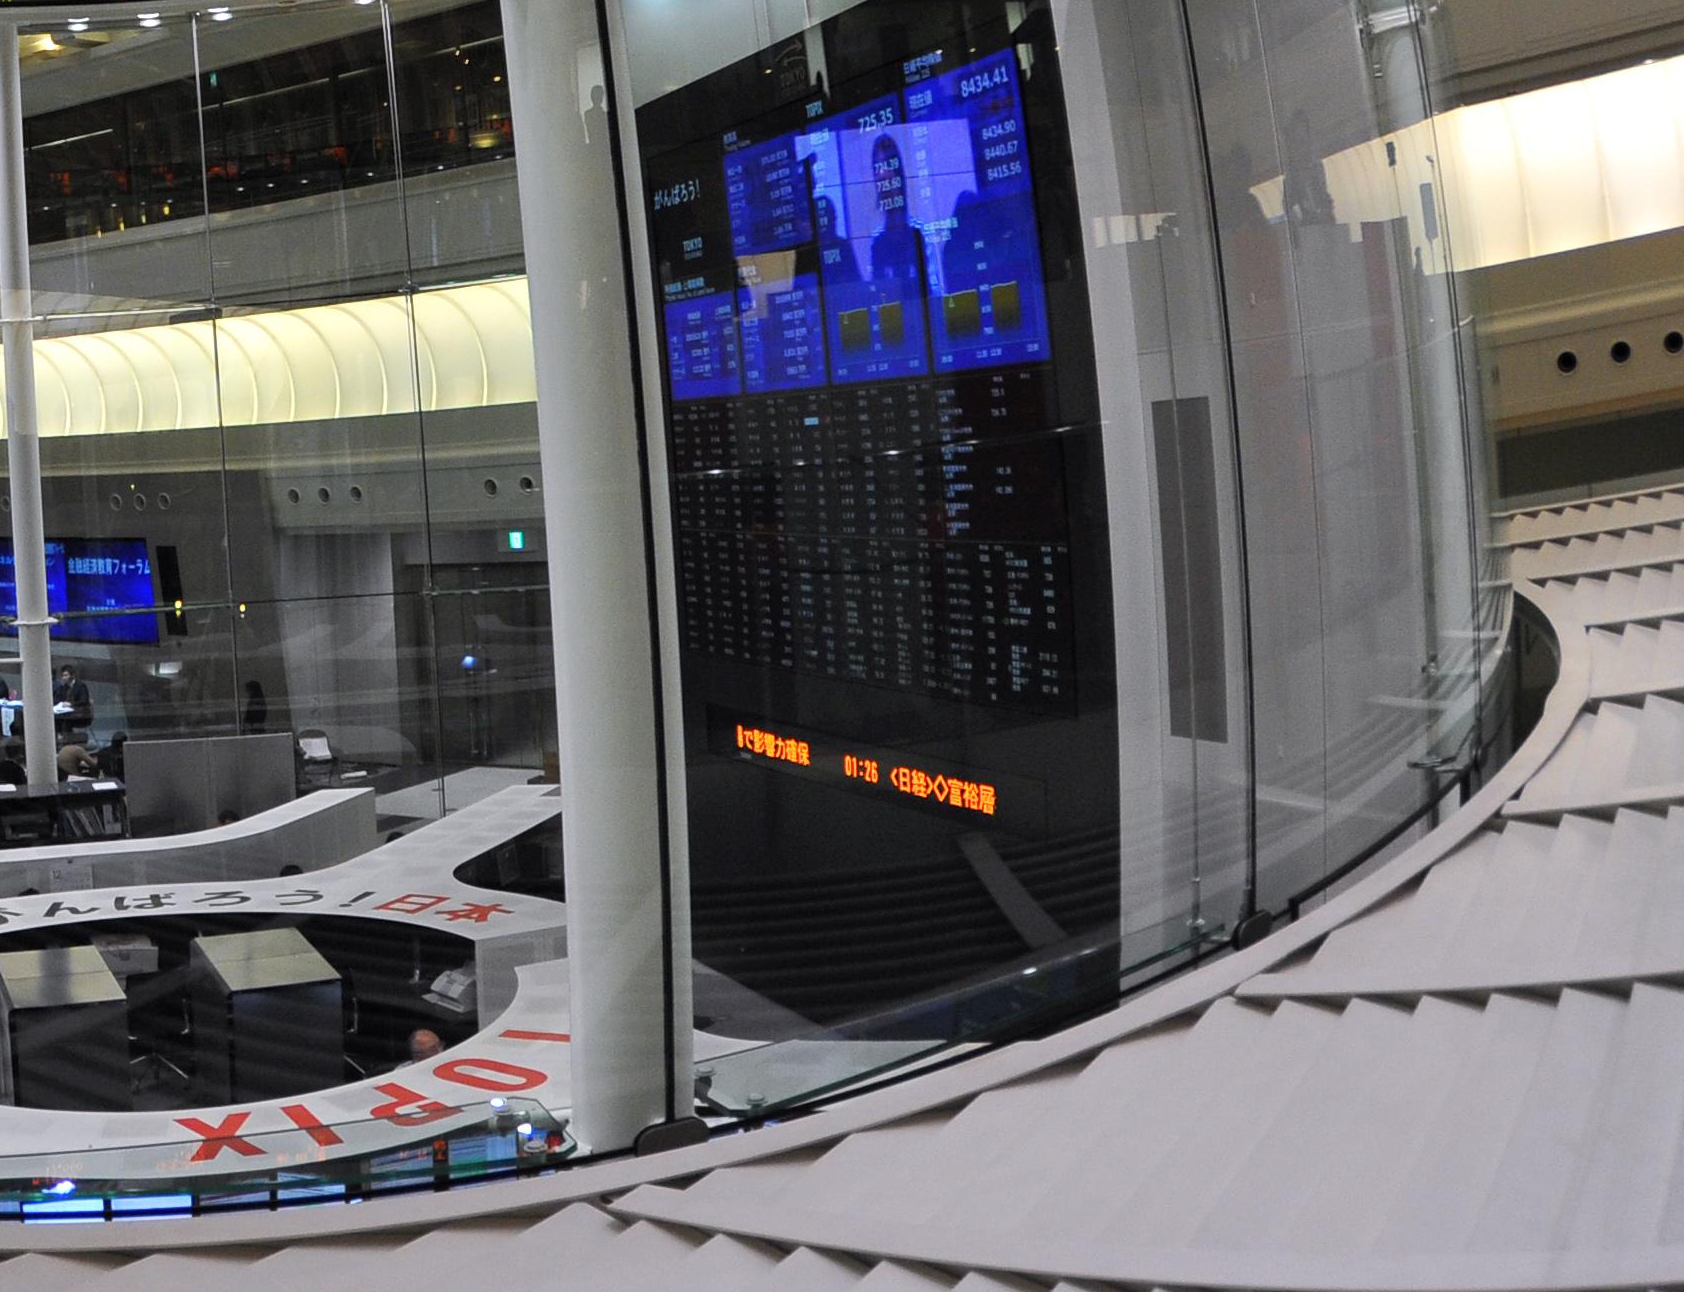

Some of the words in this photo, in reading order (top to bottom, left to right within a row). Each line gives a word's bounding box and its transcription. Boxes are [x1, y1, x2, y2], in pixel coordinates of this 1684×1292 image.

[960, 65, 1009, 98] 8434.41
[857, 107, 893, 134] 725.35
[68, 557, 152, 576] 金融経済教育フォーラム
[844, 755, 879, 784] 01:26
